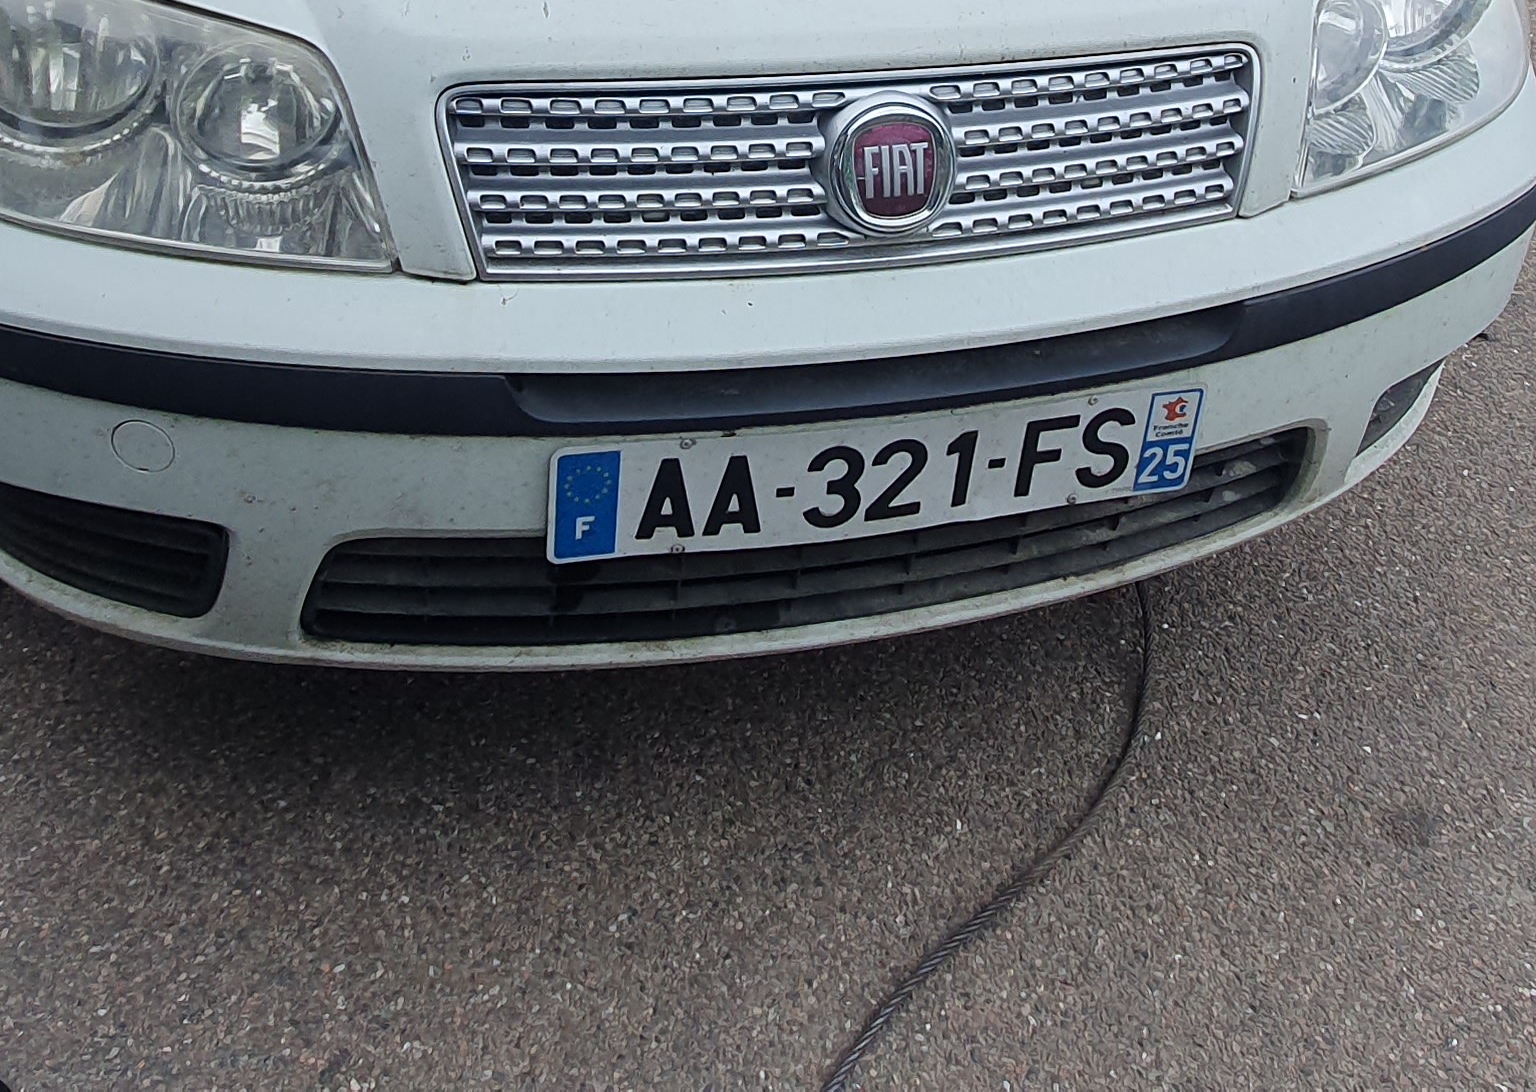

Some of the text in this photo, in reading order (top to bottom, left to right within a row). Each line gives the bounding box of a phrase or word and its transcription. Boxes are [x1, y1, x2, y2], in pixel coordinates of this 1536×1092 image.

[863, 142, 929, 199] FIAT
[635, 407, 1136, 540] AA-321-FS
[1137, 443, 1190, 484] 25
[575, 515, 595, 540] F
